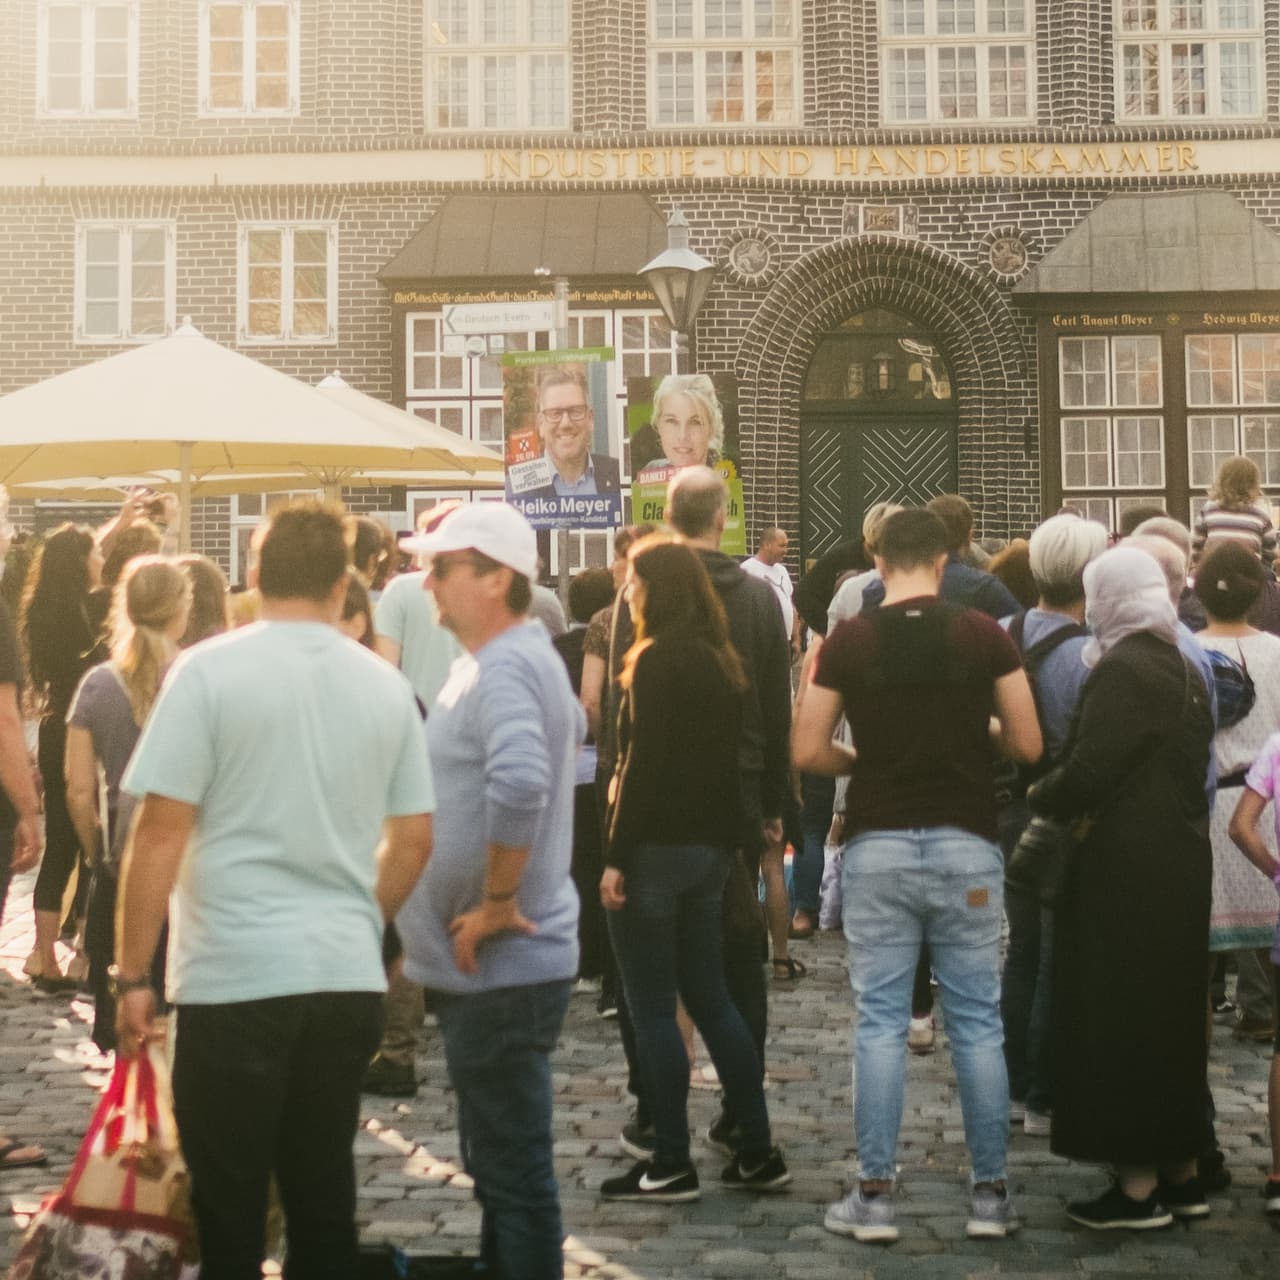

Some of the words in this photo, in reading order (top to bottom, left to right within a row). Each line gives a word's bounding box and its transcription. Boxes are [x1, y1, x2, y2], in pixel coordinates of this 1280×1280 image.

[833, 143, 1200, 176] HANDELSKAMMER
[1121, 314, 1153, 326] Meyer
[1202, 313, 1247, 325] Hedwig
[514, 497, 557, 515] Heiko
[560, 496, 612, 516] Meyer
